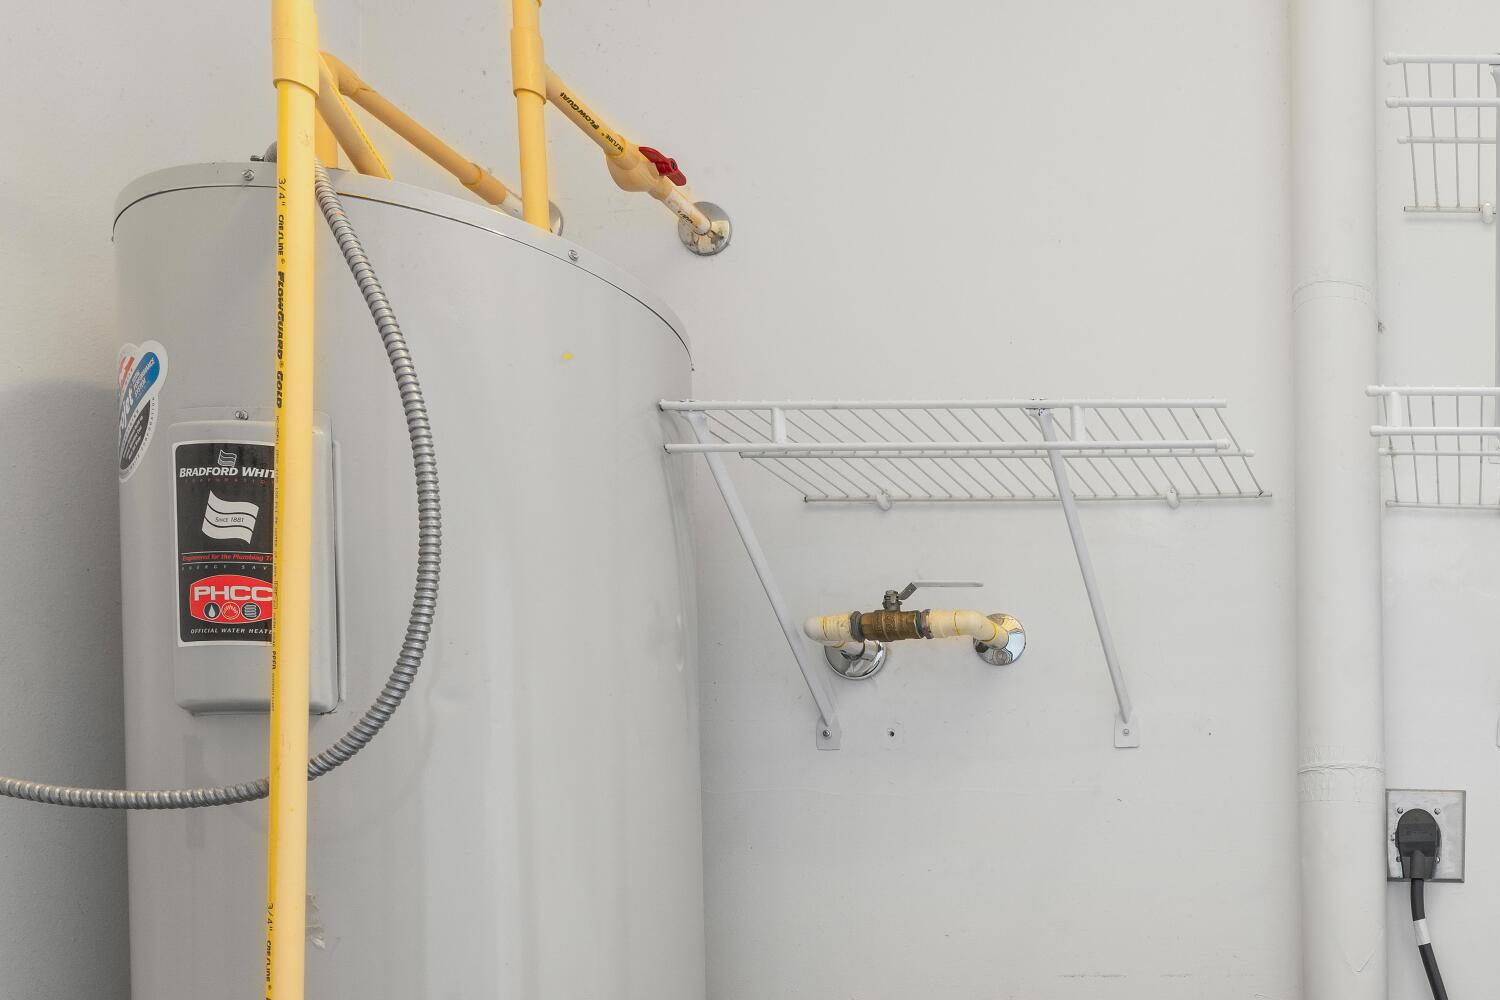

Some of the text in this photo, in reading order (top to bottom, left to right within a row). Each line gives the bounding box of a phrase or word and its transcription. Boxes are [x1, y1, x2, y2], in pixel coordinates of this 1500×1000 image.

[276, 370, 284, 409] GOLD
[179, 466, 275, 479] BRADFORD WHIT
[193, 585, 273, 602] PHCC
